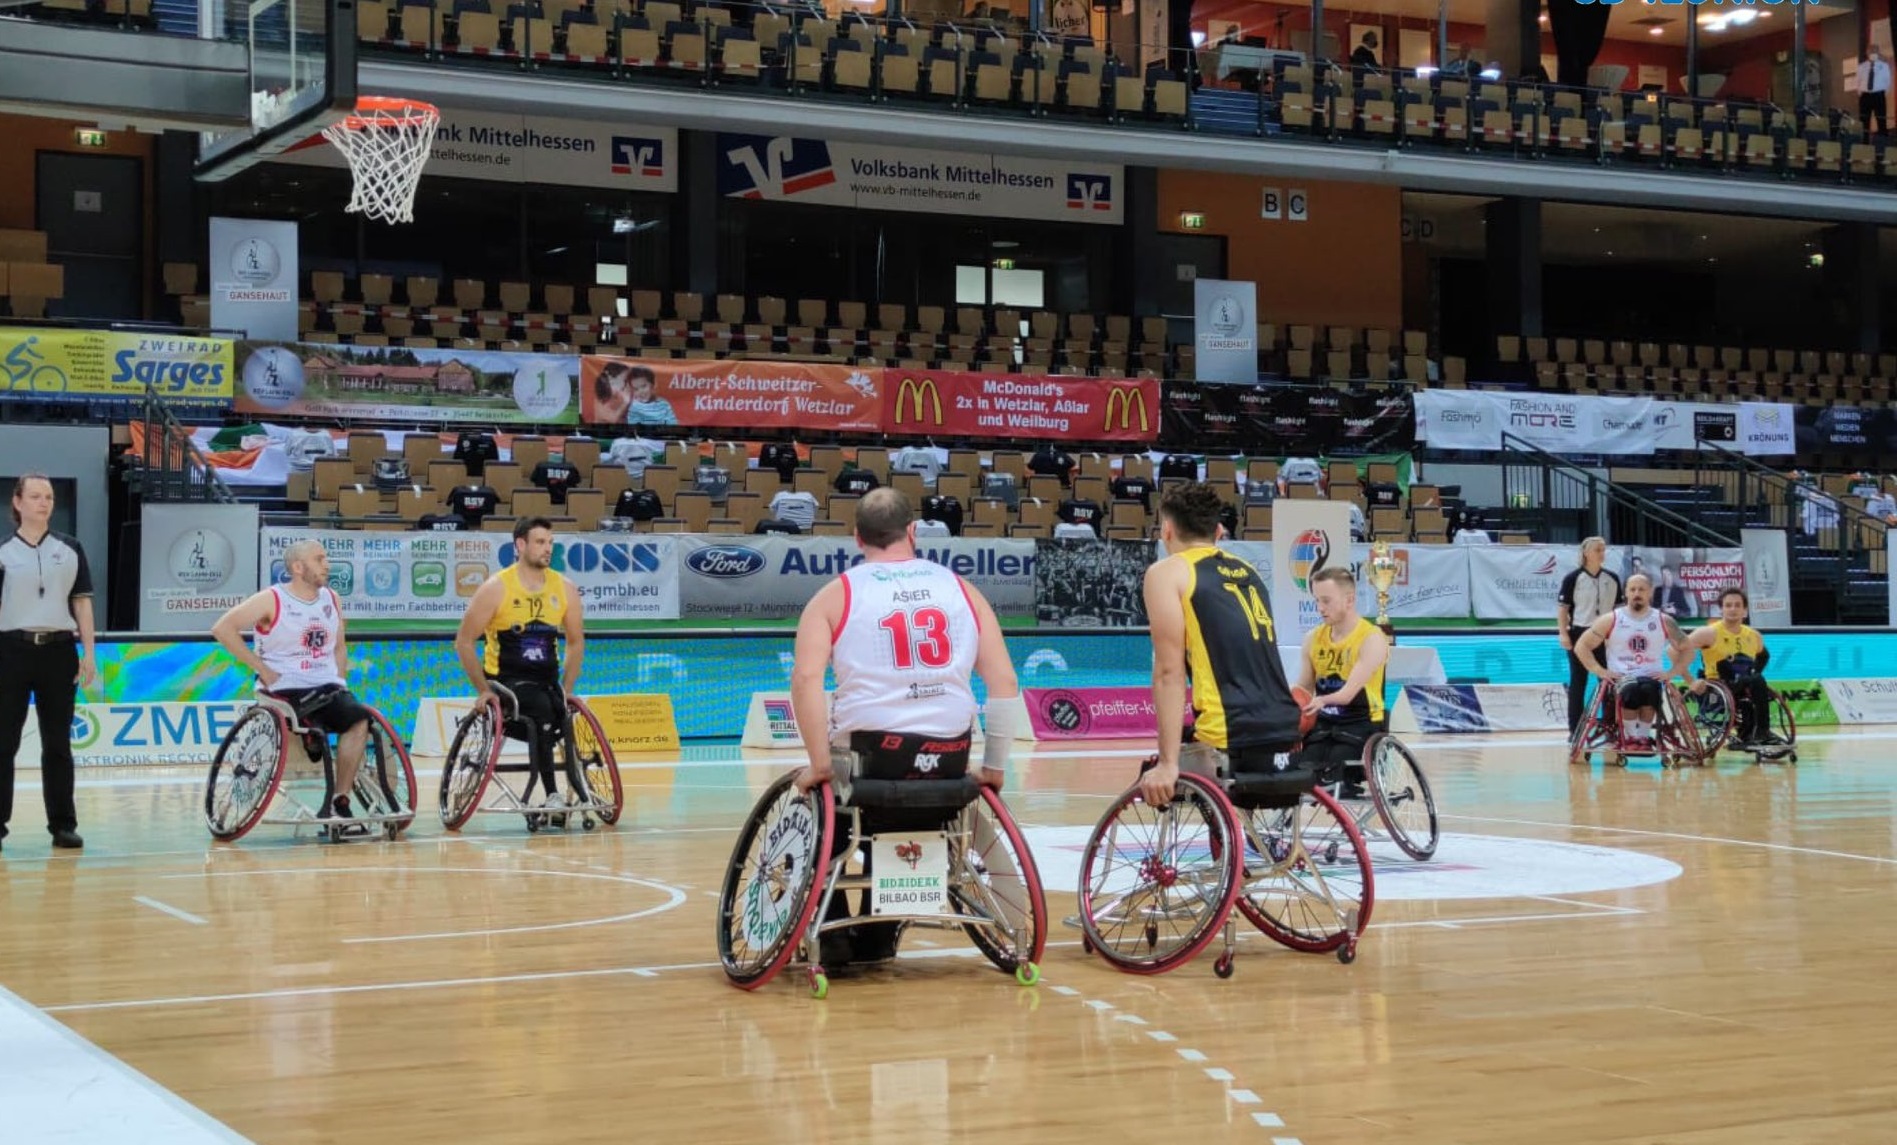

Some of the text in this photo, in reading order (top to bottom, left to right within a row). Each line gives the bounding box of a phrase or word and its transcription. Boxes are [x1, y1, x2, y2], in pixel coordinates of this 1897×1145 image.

[469, 125, 595, 153] Mittelhessen
[851, 158, 1054, 189] Volksbank Mittelhessen
[850, 183, 981, 202] www.vb-mittelhessen.de
[1264, 193, 1278, 213] B
[1290, 195, 1305, 214] C
[139, 339, 223, 353] ZWEIRAD
[111, 350, 225, 392] Sarges
[668, 372, 823, 392] Albert-Schweitzer-
[983, 380, 1064, 397] McDonald's
[694, 395, 855, 417] Kinderdorf Wetzlar
[956, 396, 1090, 414] 2x in Wetzlar, Aßlar
[977, 414, 1069, 431] und Weilburg
[363, 540, 401, 551] MEHR
[410, 540, 447, 551] MEHR
[454, 540, 491, 551] MEHR
[700, 549, 752, 573] Ford
[915, 547, 1036, 577] Weller
[1680, 563, 1742, 578] PERSÖNLICH
[1688, 578, 1742, 589] INNOVATIV
[893, 589, 931, 602] ASIER
[354, 602, 371, 612] mit
[374, 602, 405, 612] Ihrem
[408, 600, 468, 612] Fachbetrieb
[526, 597, 545, 618] 12
[599, 602, 660, 612] Mittelhessen
[1223, 582, 1274, 643] 14
[879, 606, 953, 670] 13
[1326, 649, 1343, 671] 24
[770, 721, 797, 730] RITTAL
[879, 891, 941, 904] BILBAO BSR
